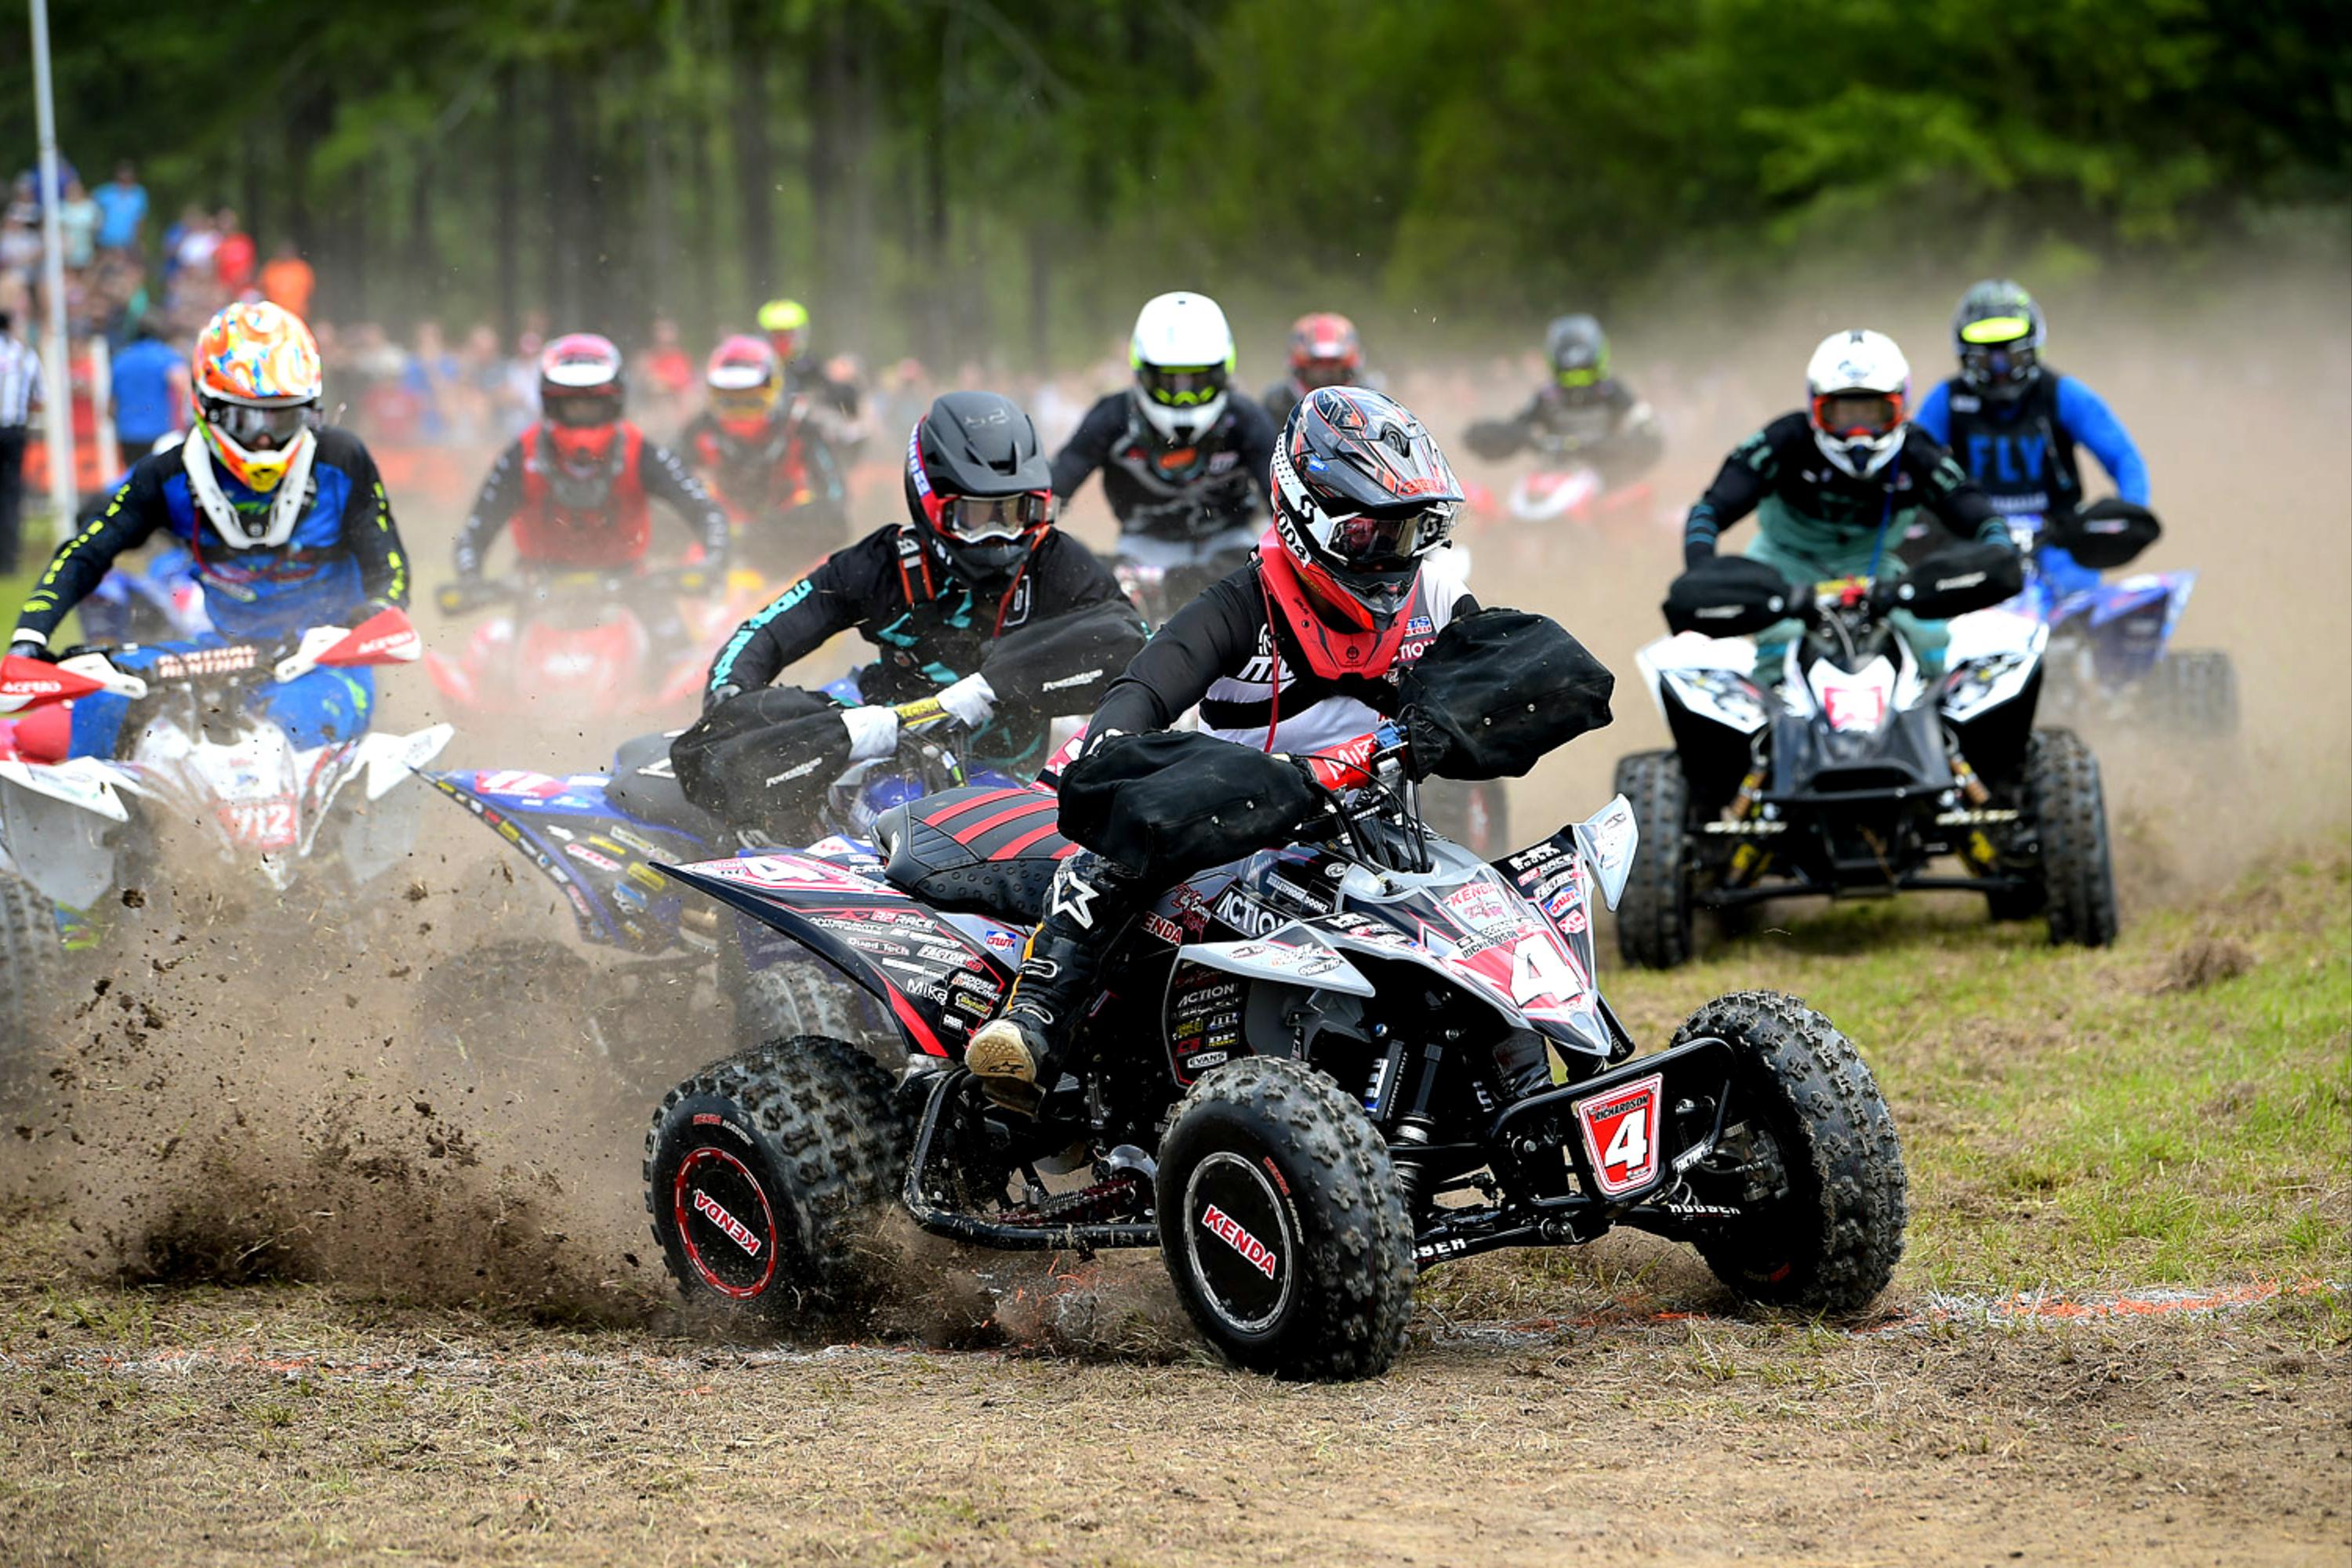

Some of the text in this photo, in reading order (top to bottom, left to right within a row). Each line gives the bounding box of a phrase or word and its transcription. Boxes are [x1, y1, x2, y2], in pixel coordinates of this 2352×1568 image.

[1967, 434, 2044, 481] FLY
[160, 655, 255, 678] RENTHAL
[231, 804, 291, 838] 712
[1450, 882, 1497, 907] KENDA
[1141, 911, 1183, 946] ENDA
[956, 971, 998, 990] MOOSE
[1510, 931, 1585, 1009] 4
[961, 981, 1002, 1003] RACING
[1178, 983, 1236, 1008] ACTION
[1189, 1053, 1225, 1066] EVANS
[1594, 1094, 1650, 1123] RICHARDSON
[1604, 1107, 1647, 1171] 4
[694, 1188, 762, 1257] KENDA
[1201, 1203, 1277, 1279] KENDA
